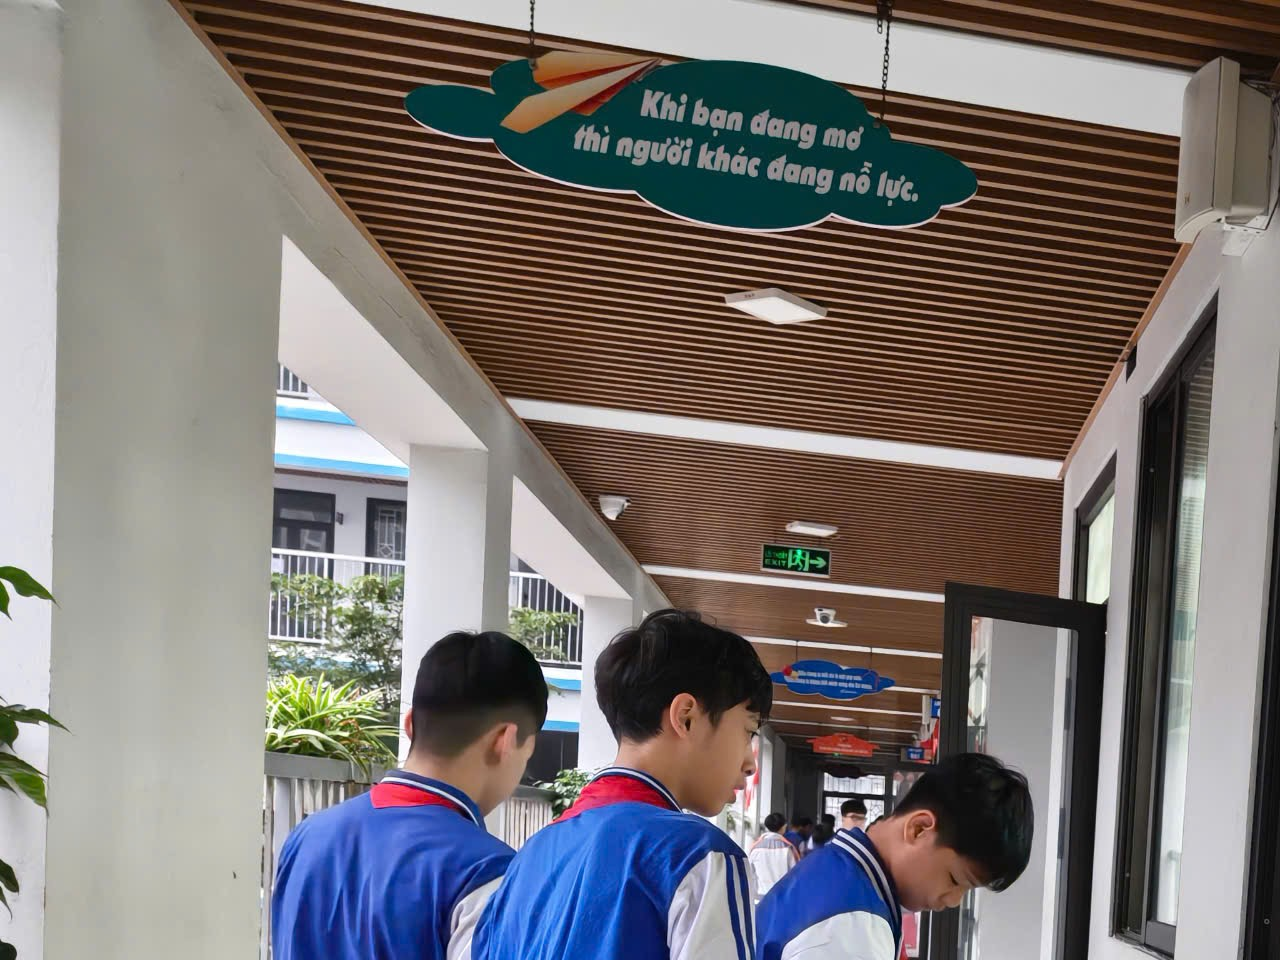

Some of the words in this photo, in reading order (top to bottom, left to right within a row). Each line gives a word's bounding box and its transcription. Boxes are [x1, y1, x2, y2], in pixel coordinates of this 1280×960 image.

[640, 88, 688, 123] Khi
[691, 98, 744, 137] bạn
[750, 109, 818, 150] đang
[822, 126, 865, 151] mơ
[573, 124, 610, 154] thì
[615, 136, 694, 167] người
[696, 142, 761, 178] khác
[766, 154, 834, 195] đang
[838, 161, 873, 195] nỗ
[876, 170, 919, 207] lực.
